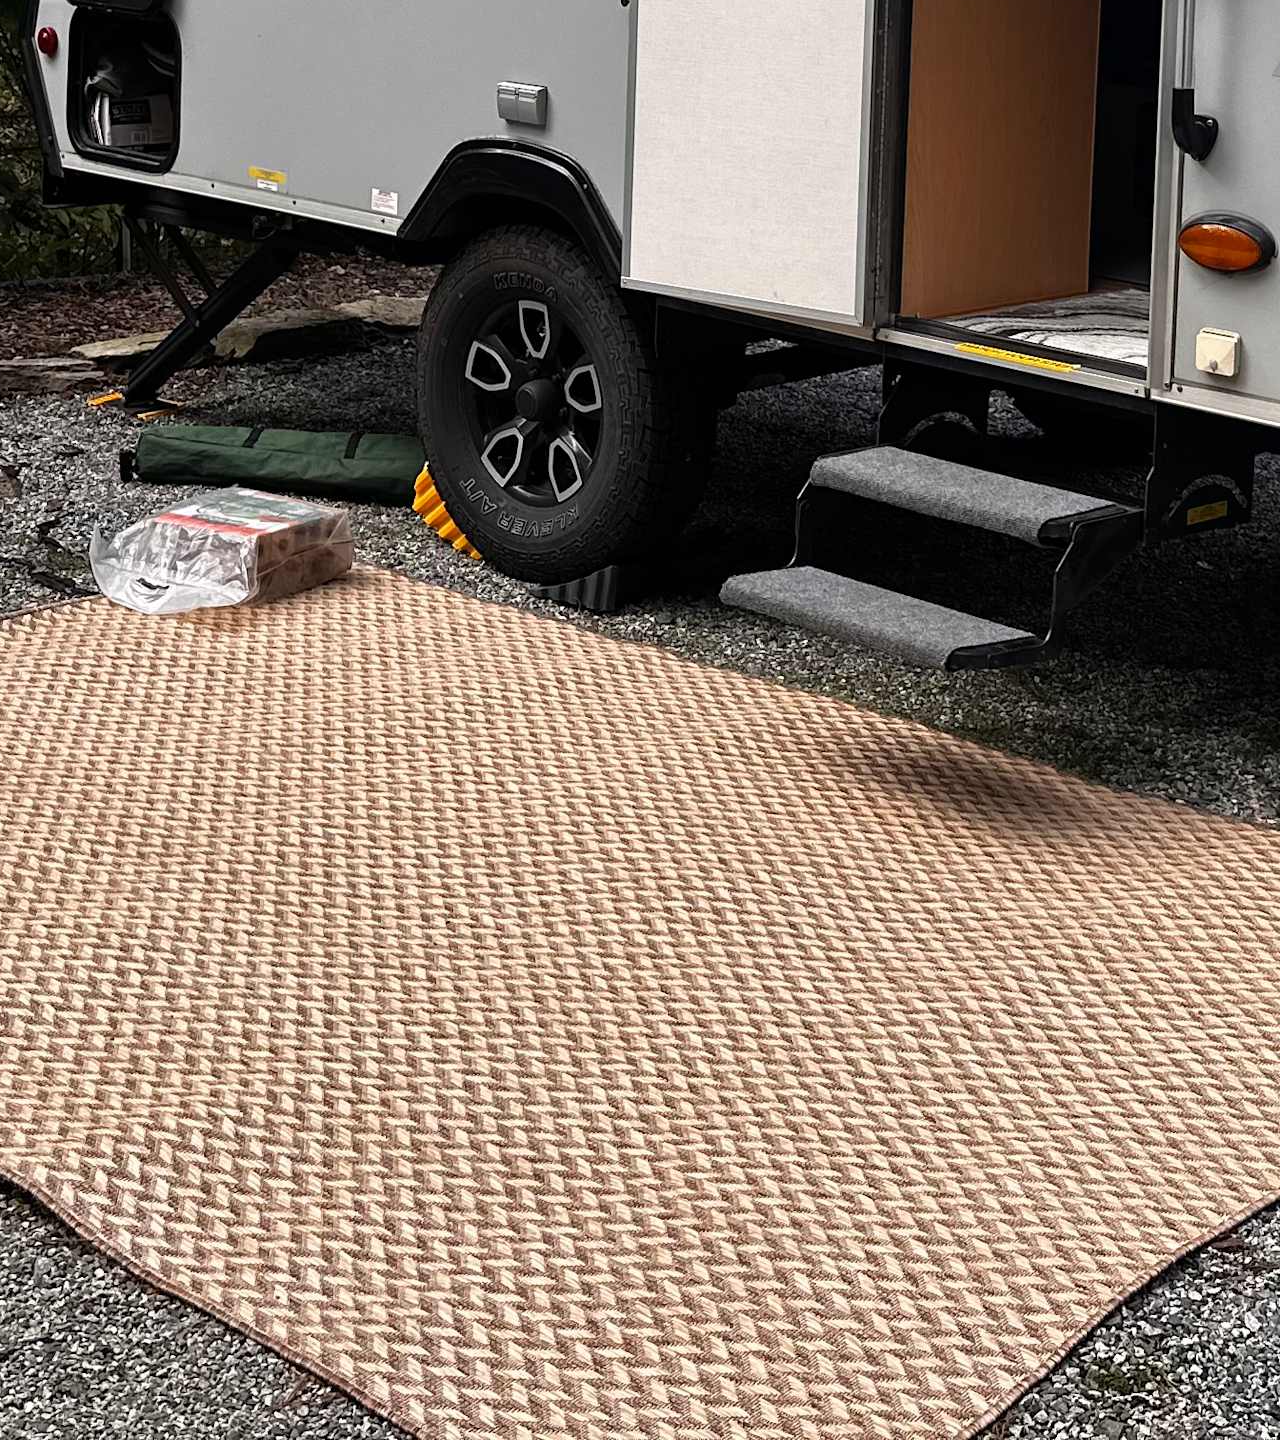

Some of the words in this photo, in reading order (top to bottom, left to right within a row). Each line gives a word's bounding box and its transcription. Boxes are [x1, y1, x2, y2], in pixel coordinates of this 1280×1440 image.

[493, 271, 557, 302] KENDA
[460, 478, 497, 515] A/T
[497, 502, 579, 536] KLEVER
